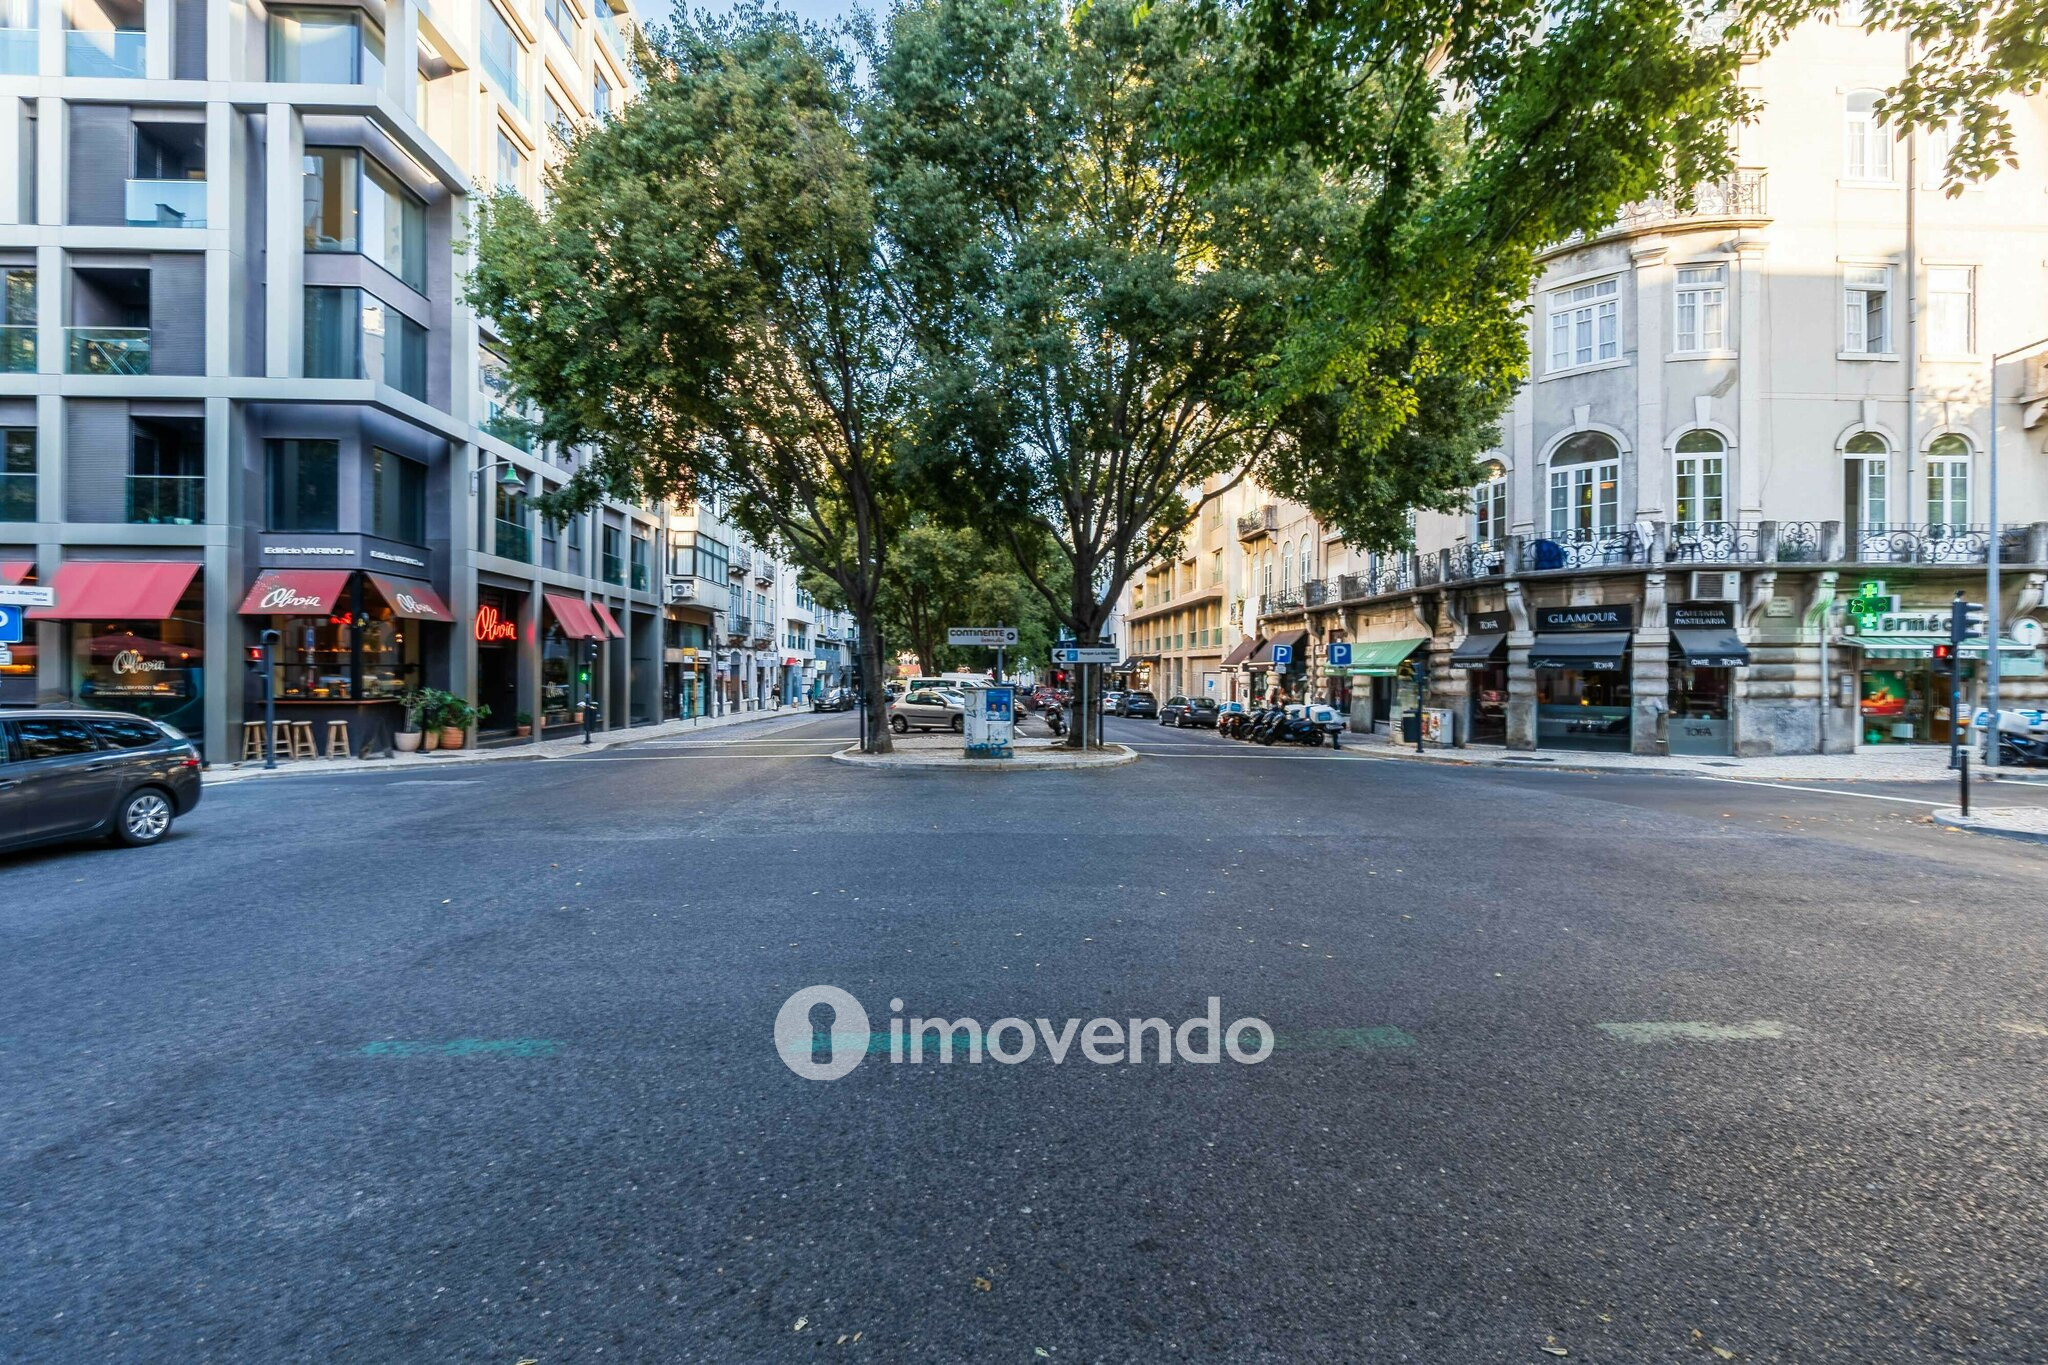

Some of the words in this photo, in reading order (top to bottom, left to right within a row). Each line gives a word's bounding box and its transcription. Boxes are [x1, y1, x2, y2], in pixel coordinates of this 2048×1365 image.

[301, 547, 344, 555] VARINO
[261, 588, 321, 608] Olivia
[475, 605, 518, 641] Olivia
[1547, 611, 1619, 624] GLAMOUR
[950, 629, 1005, 637] CONTINENTE
[112, 650, 166, 674] Olivia
[1276, 647, 1288, 661] P
[1334, 645, 1348, 663] P
